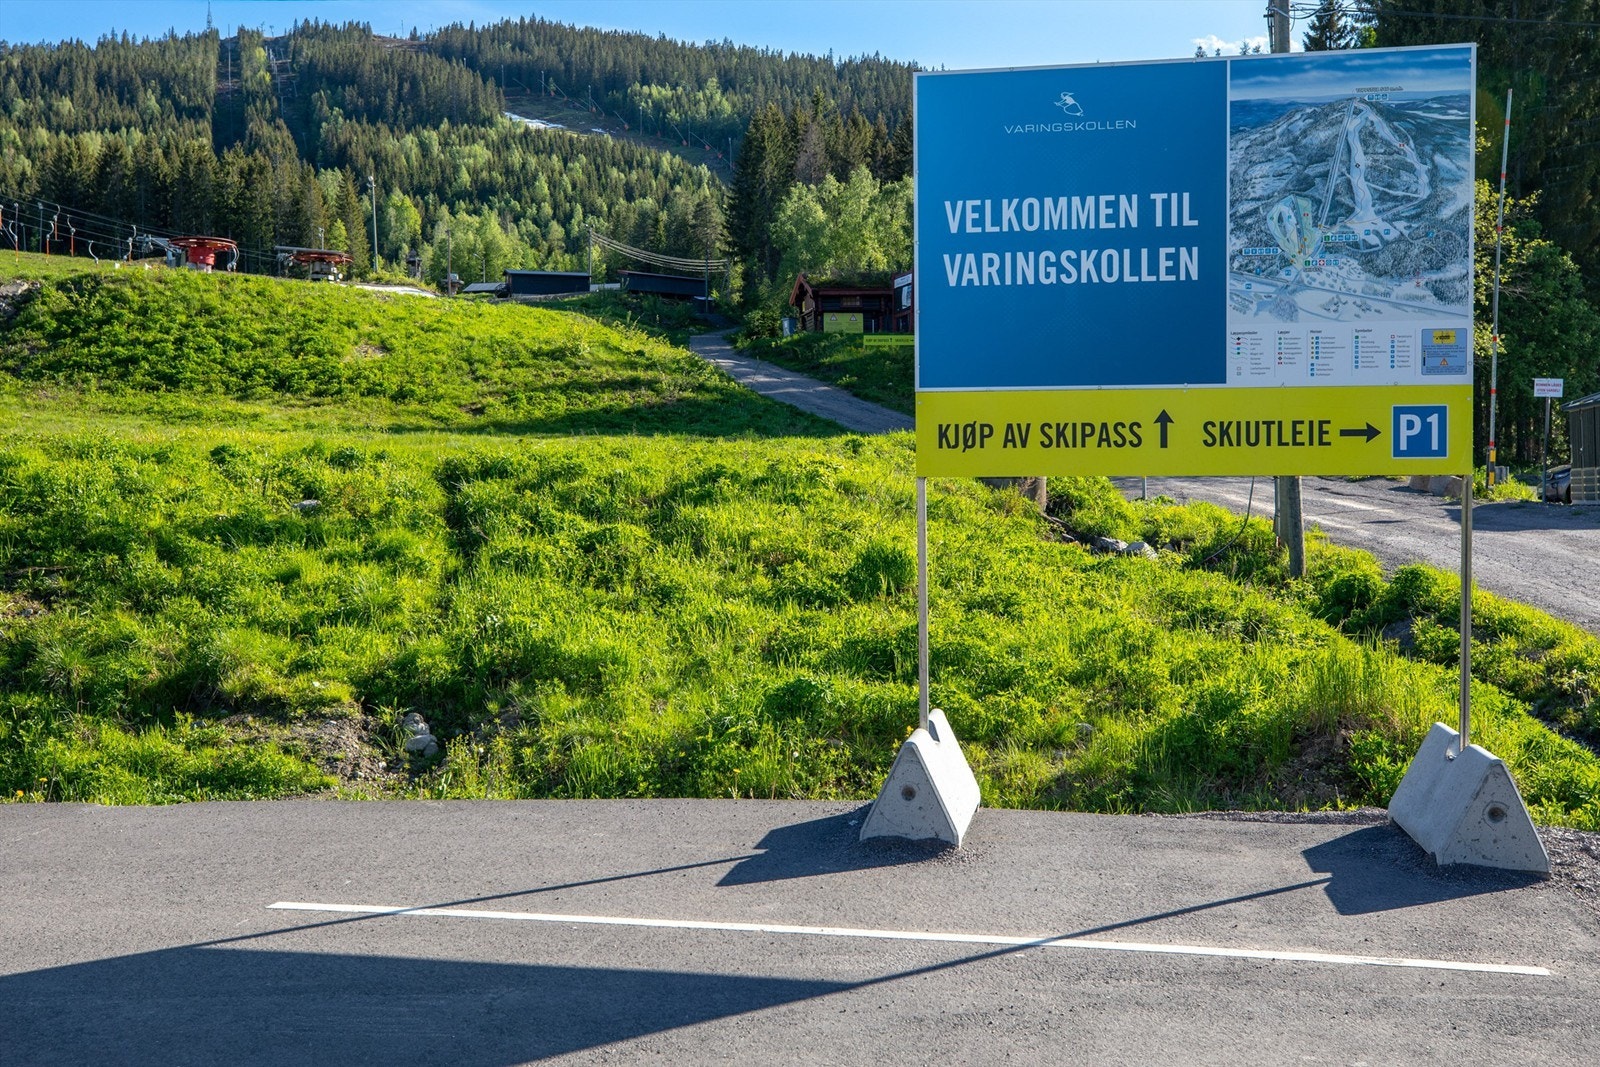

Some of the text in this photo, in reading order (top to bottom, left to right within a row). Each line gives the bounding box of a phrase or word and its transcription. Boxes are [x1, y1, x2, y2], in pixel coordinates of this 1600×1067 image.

[1004, 120, 1137, 134] VARINGSKOLLEN
[944, 192, 1199, 234] VELKOMMEN TIL
[943, 246, 1199, 287] VARINGSKOLLEN
[938, 421, 1143, 453] KJØP AV SKIPASS
[1202, 420, 1332, 447] SKIUTLEIE
[1399, 413, 1439, 450] P1
